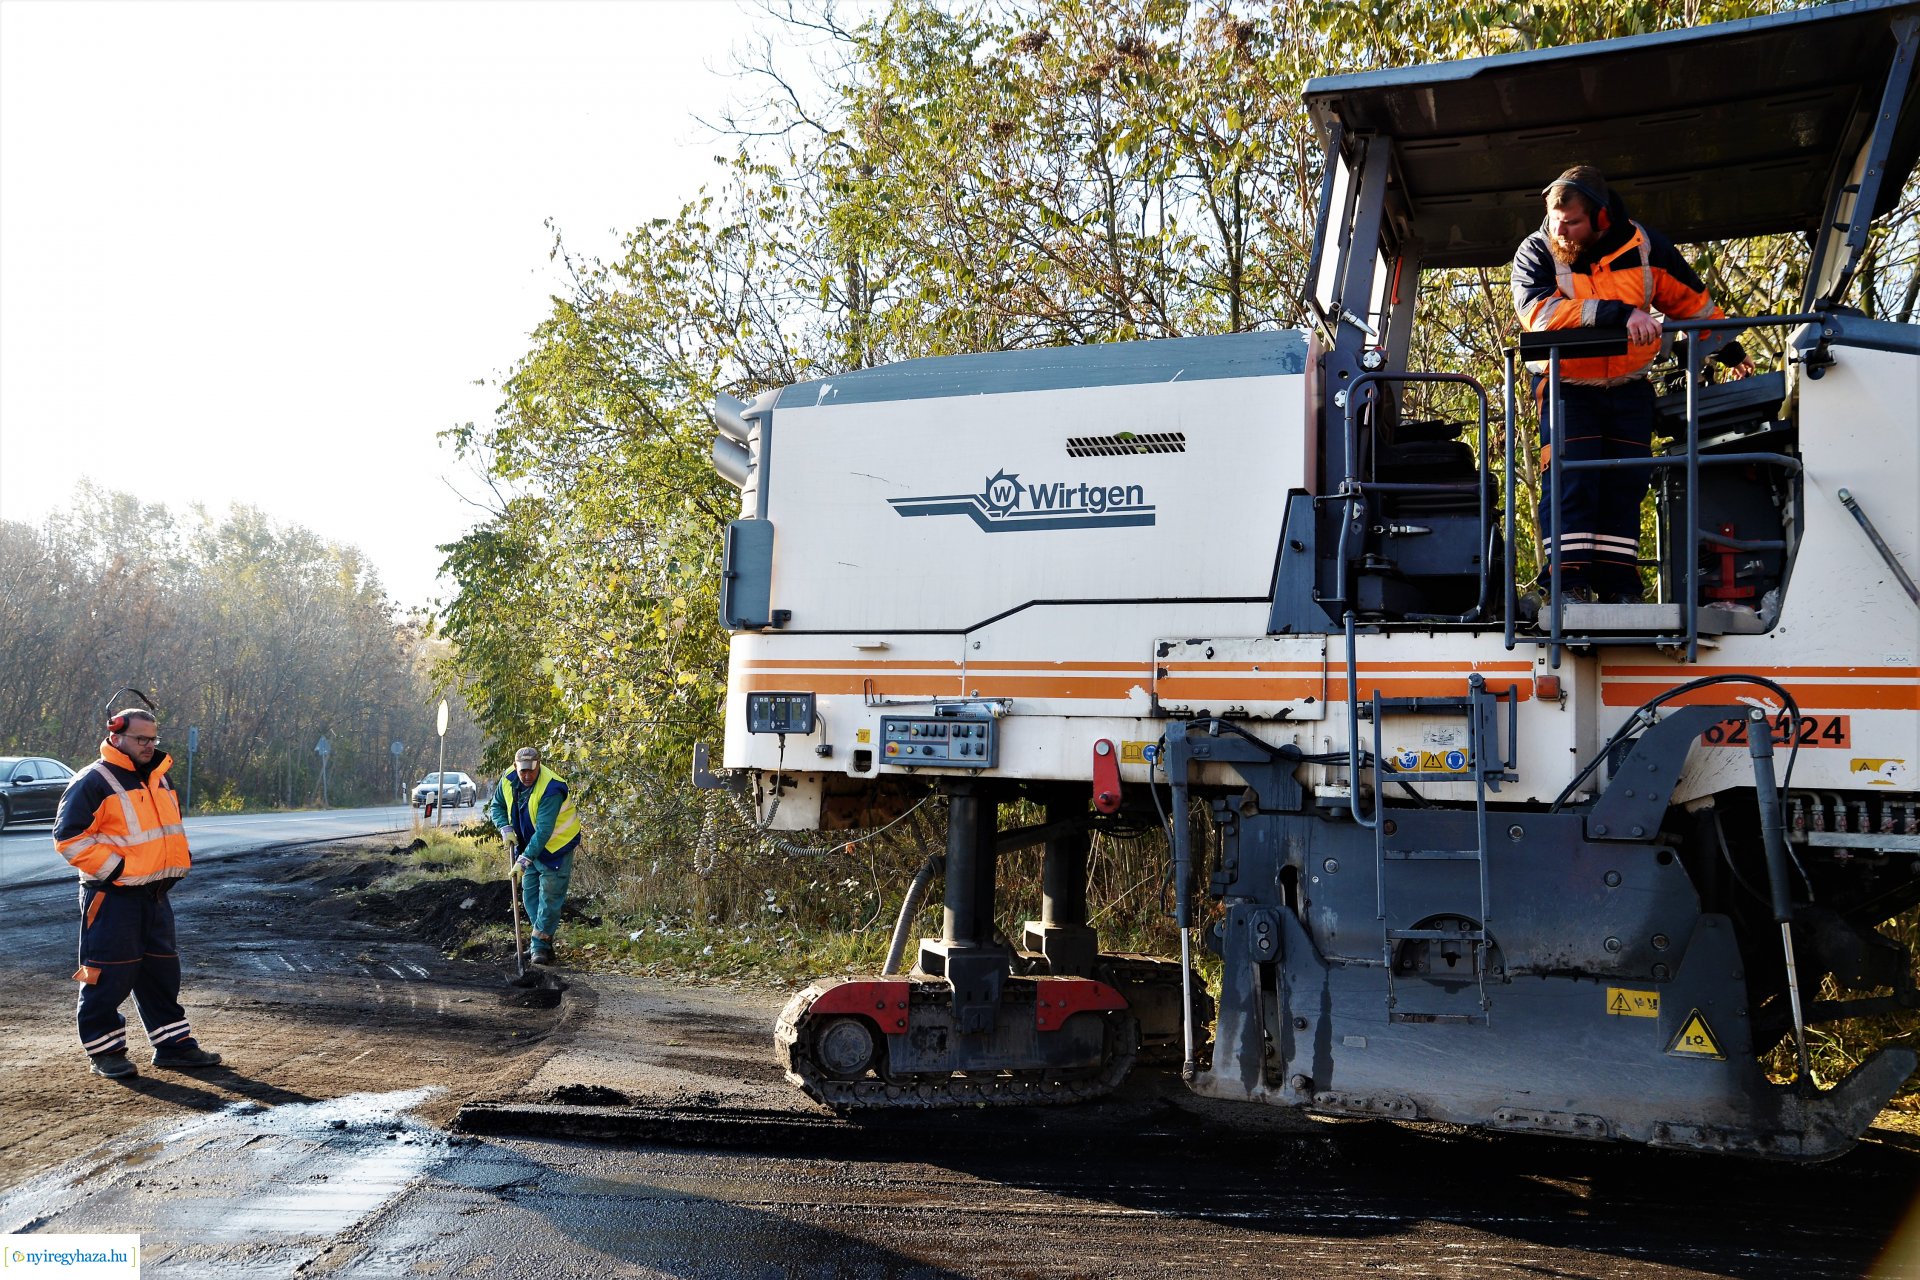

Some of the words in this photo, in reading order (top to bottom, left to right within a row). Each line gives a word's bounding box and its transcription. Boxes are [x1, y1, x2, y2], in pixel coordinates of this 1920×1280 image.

[993, 485, 1012, 503] W
[1028, 482, 1144, 514] Wirtgen
[1704, 716, 1846, 745] 62124
